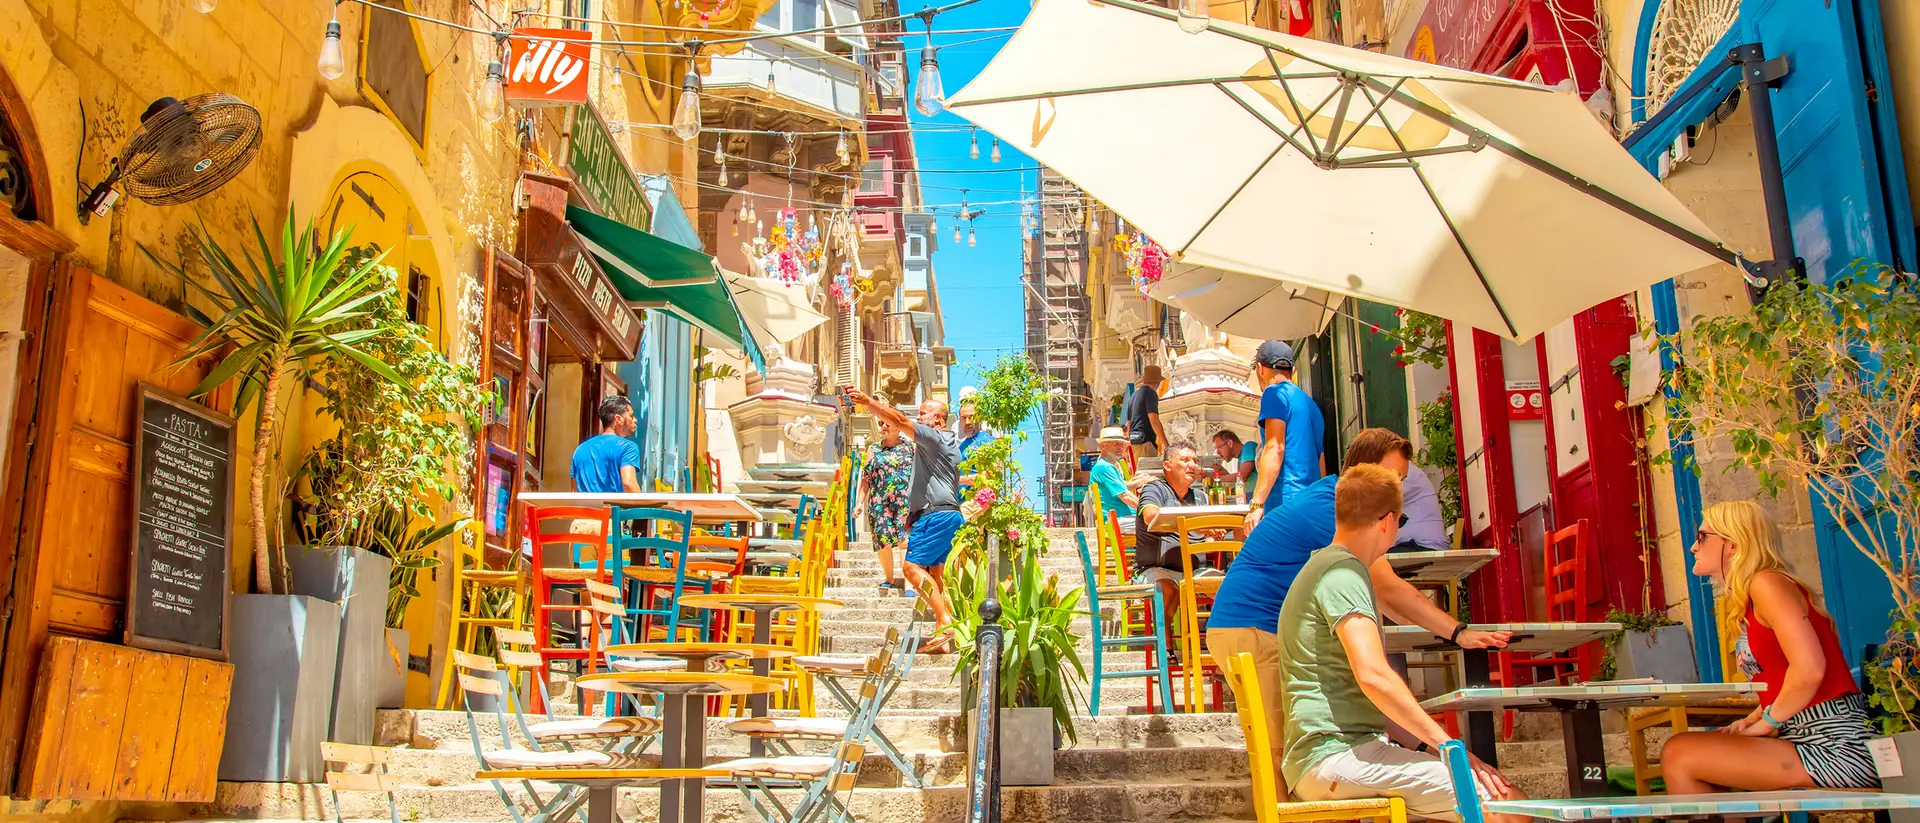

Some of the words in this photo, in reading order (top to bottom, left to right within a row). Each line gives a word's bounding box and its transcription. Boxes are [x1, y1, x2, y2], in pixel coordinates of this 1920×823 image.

[512, 40, 584, 95] illy
[575, 103, 595, 162] SAN
[591, 127, 618, 200] PAOLO
[571, 251, 593, 290] PIZZA
[591, 276, 613, 316] PASTA
[170, 413, 202, 439] PASTA
[1583, 766, 1602, 780] 22
